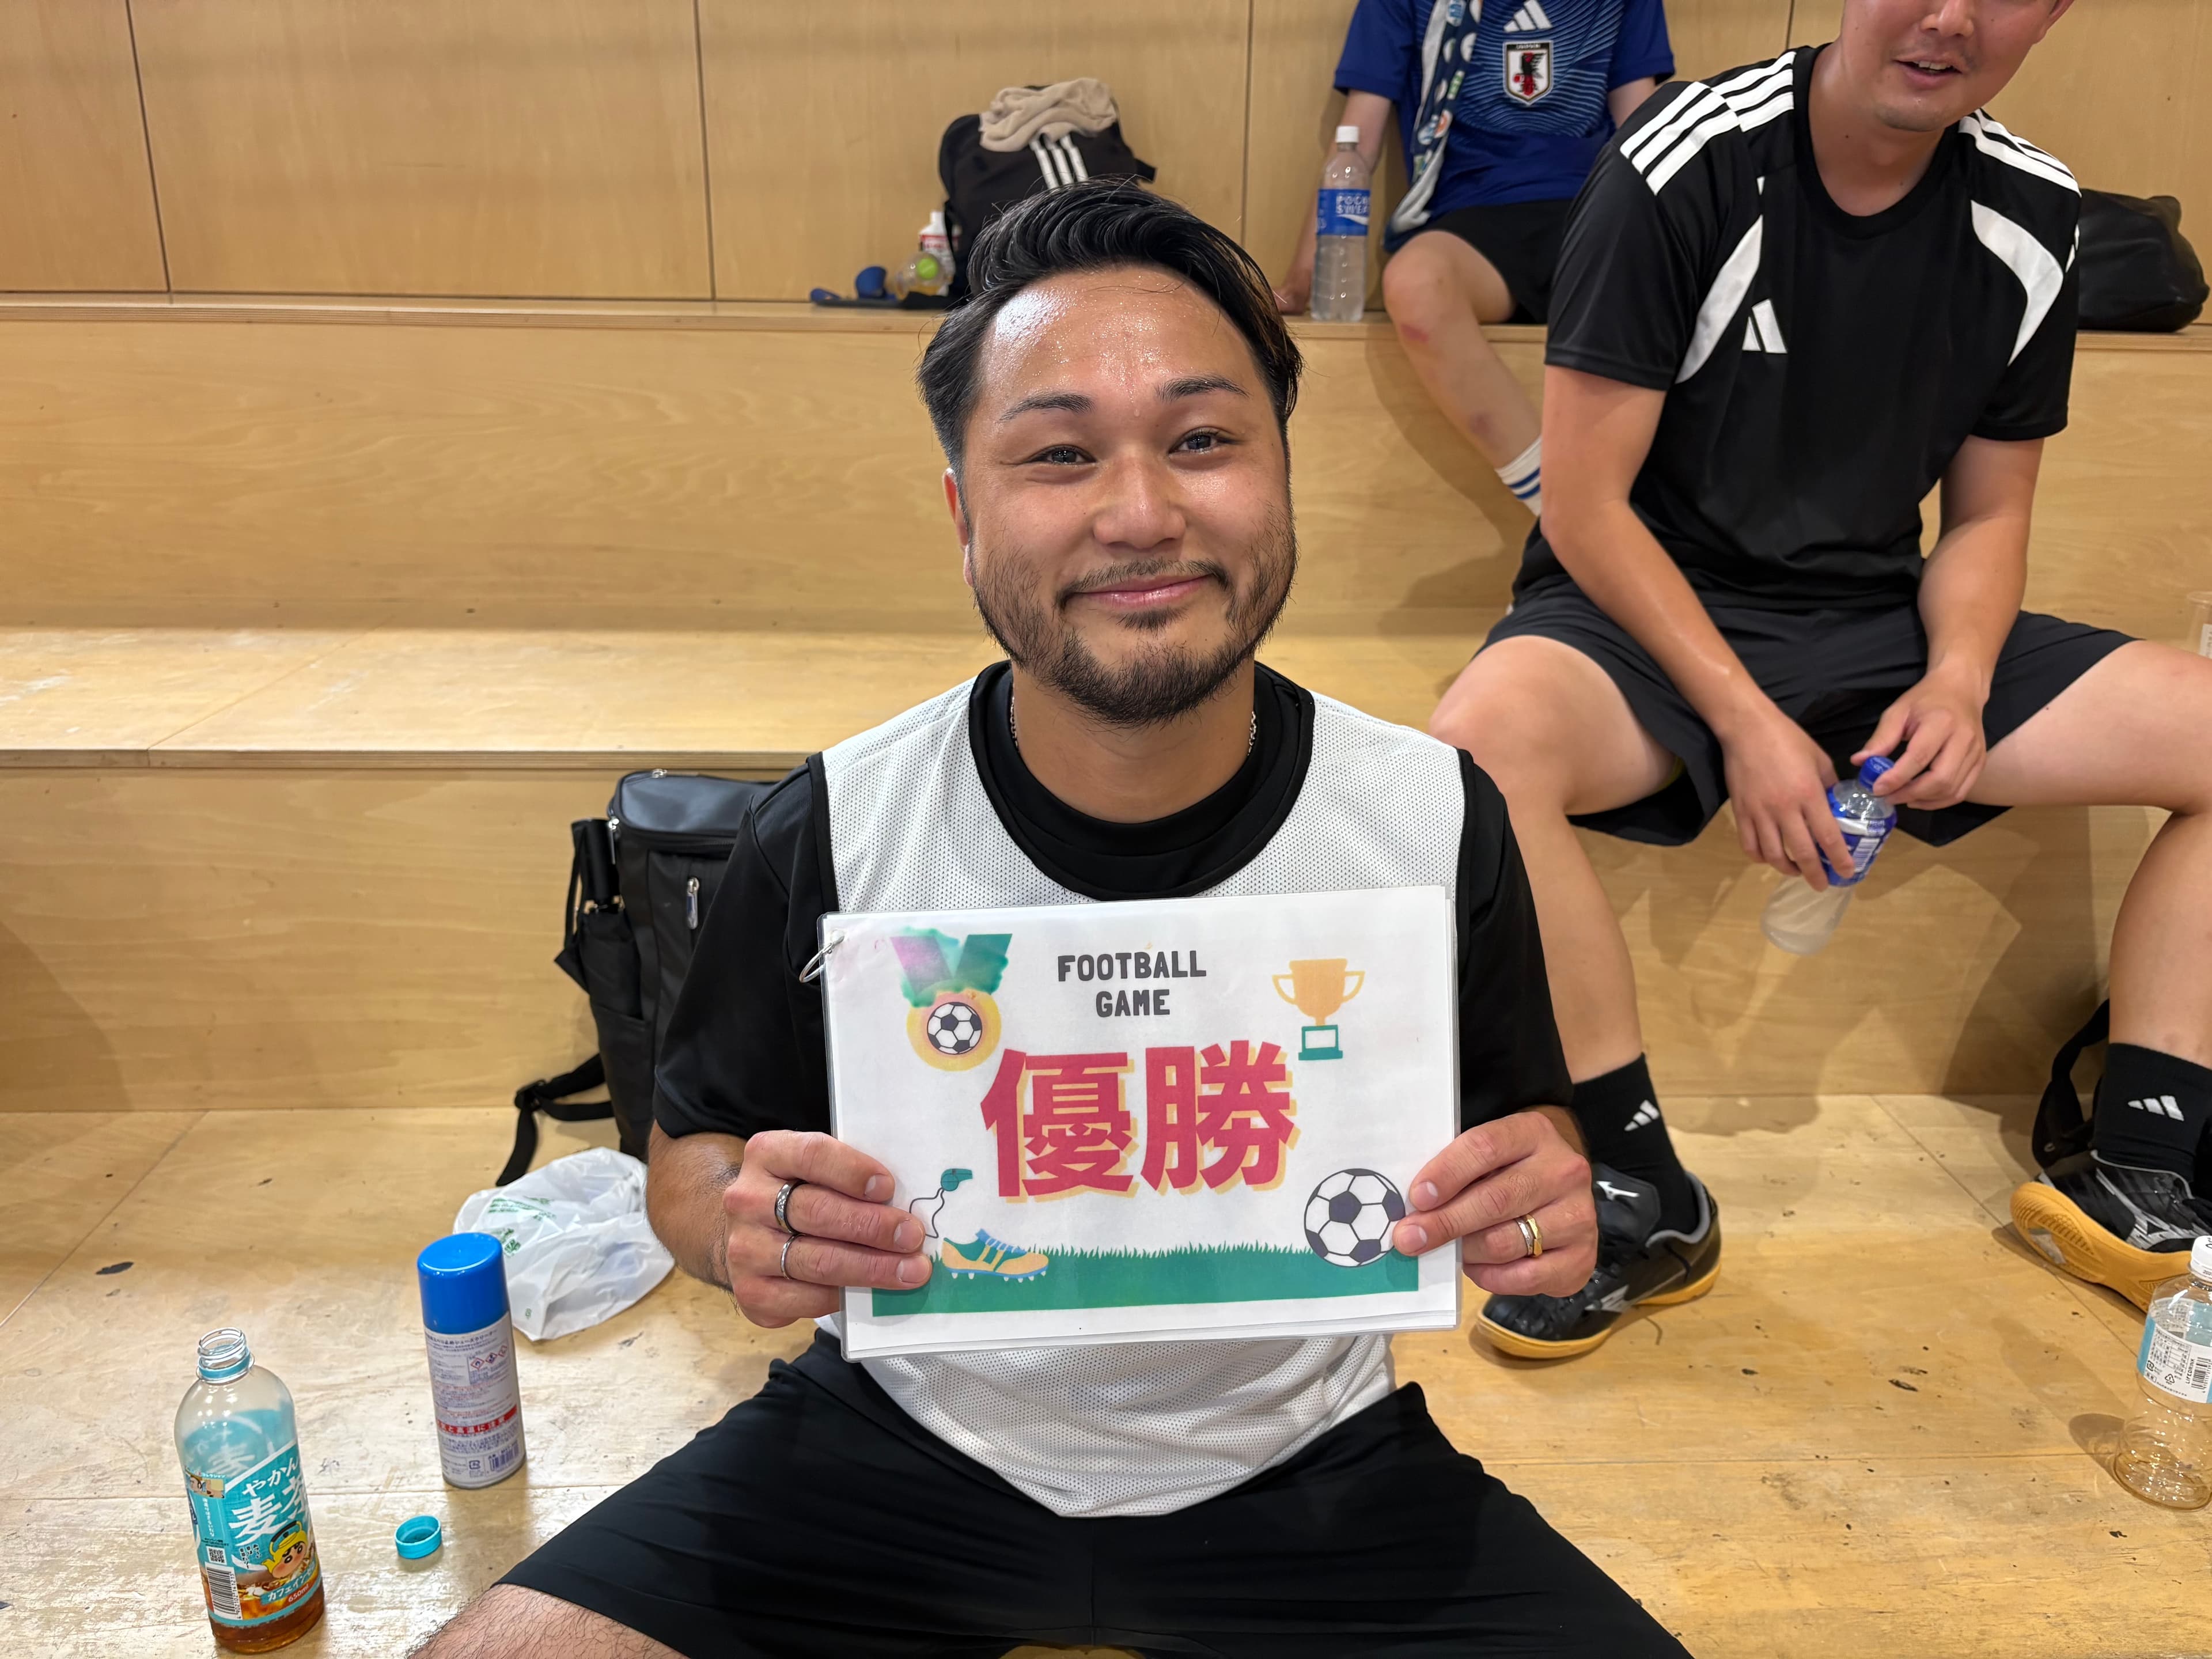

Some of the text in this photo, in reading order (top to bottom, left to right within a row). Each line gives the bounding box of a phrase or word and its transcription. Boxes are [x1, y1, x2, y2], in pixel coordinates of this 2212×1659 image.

[1058, 950, 1207, 982] FOOTBALL
[1096, 989, 1170, 1018] GAME
[980, 1040, 1296, 1199] 優勝
[2186, 1358, 2195, 1384] LIFEDRINK
[228, 1475, 308, 1547] 麦茶
[288, 1584, 309, 1603] 650ml
